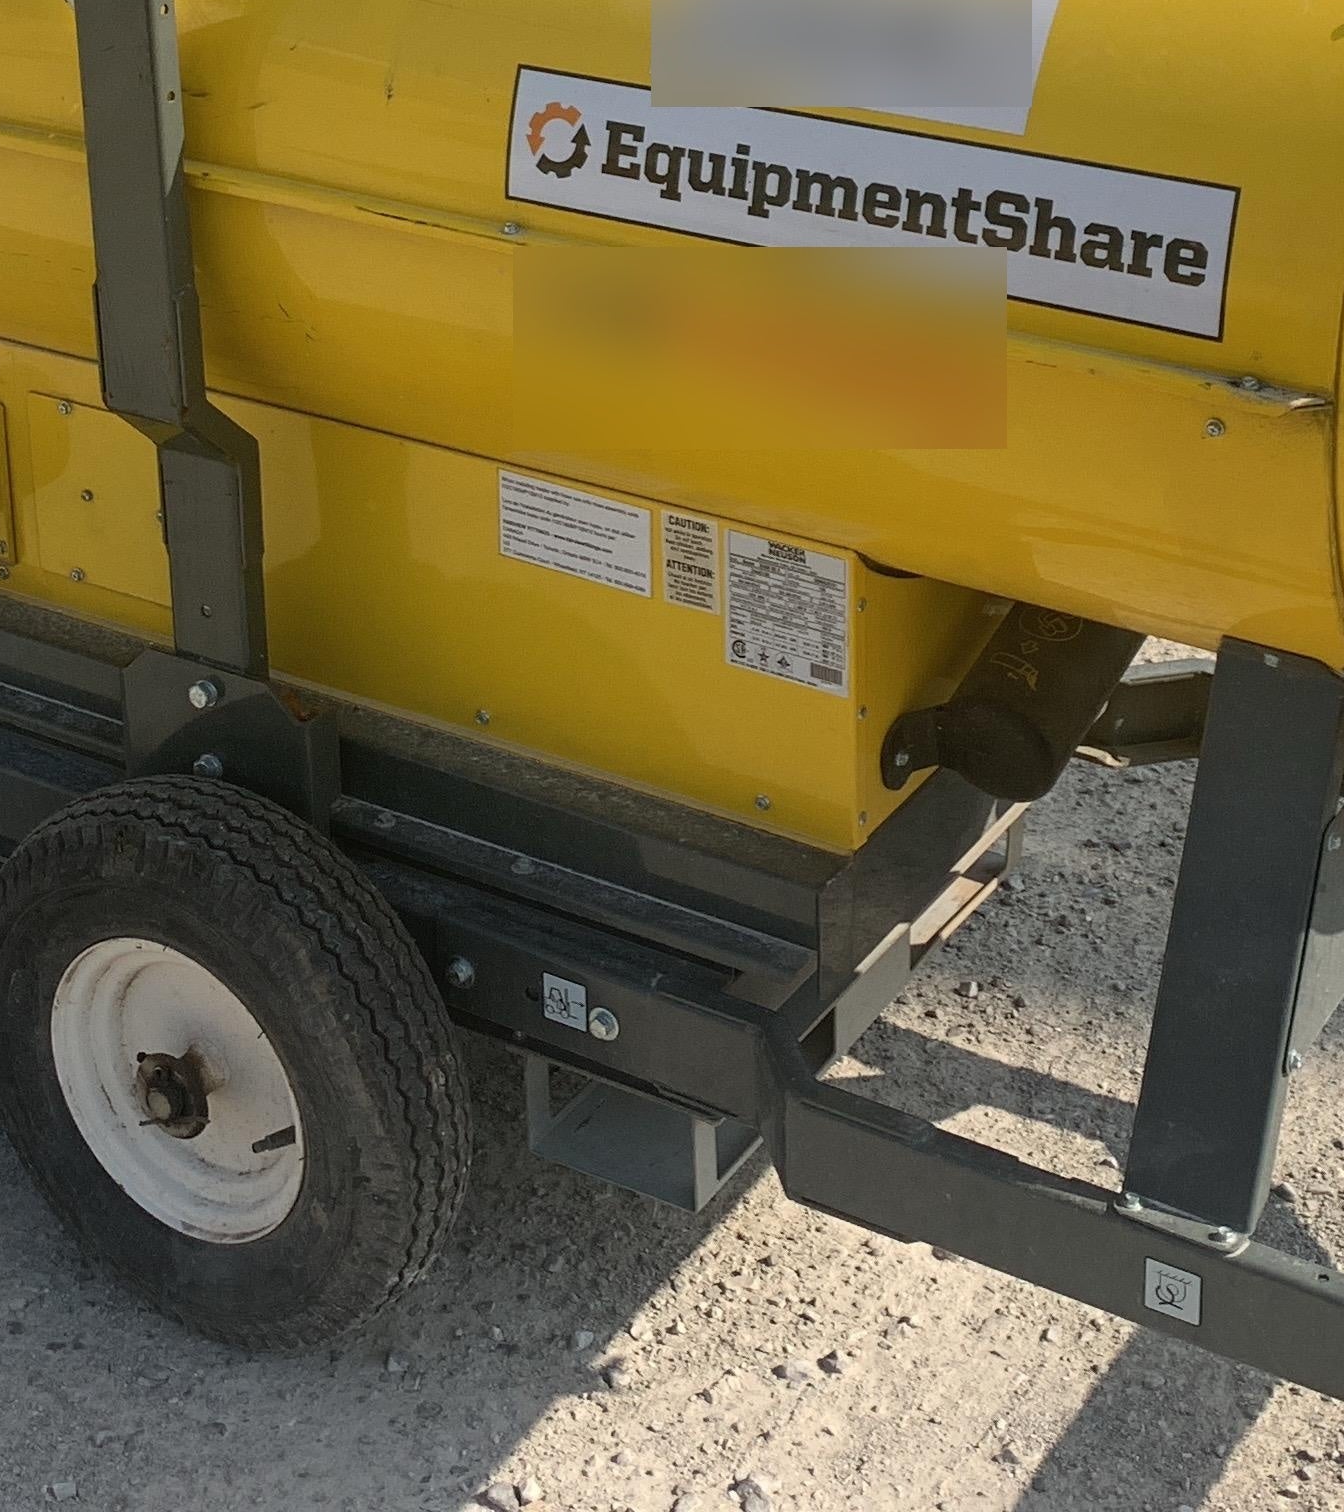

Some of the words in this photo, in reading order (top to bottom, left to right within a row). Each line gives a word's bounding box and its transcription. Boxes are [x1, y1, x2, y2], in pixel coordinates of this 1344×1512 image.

[601, 120, 1209, 286] EquipmentShare
[668, 515, 710, 534] CAUTION:
[666, 559, 716, 580] ATTENTION:
